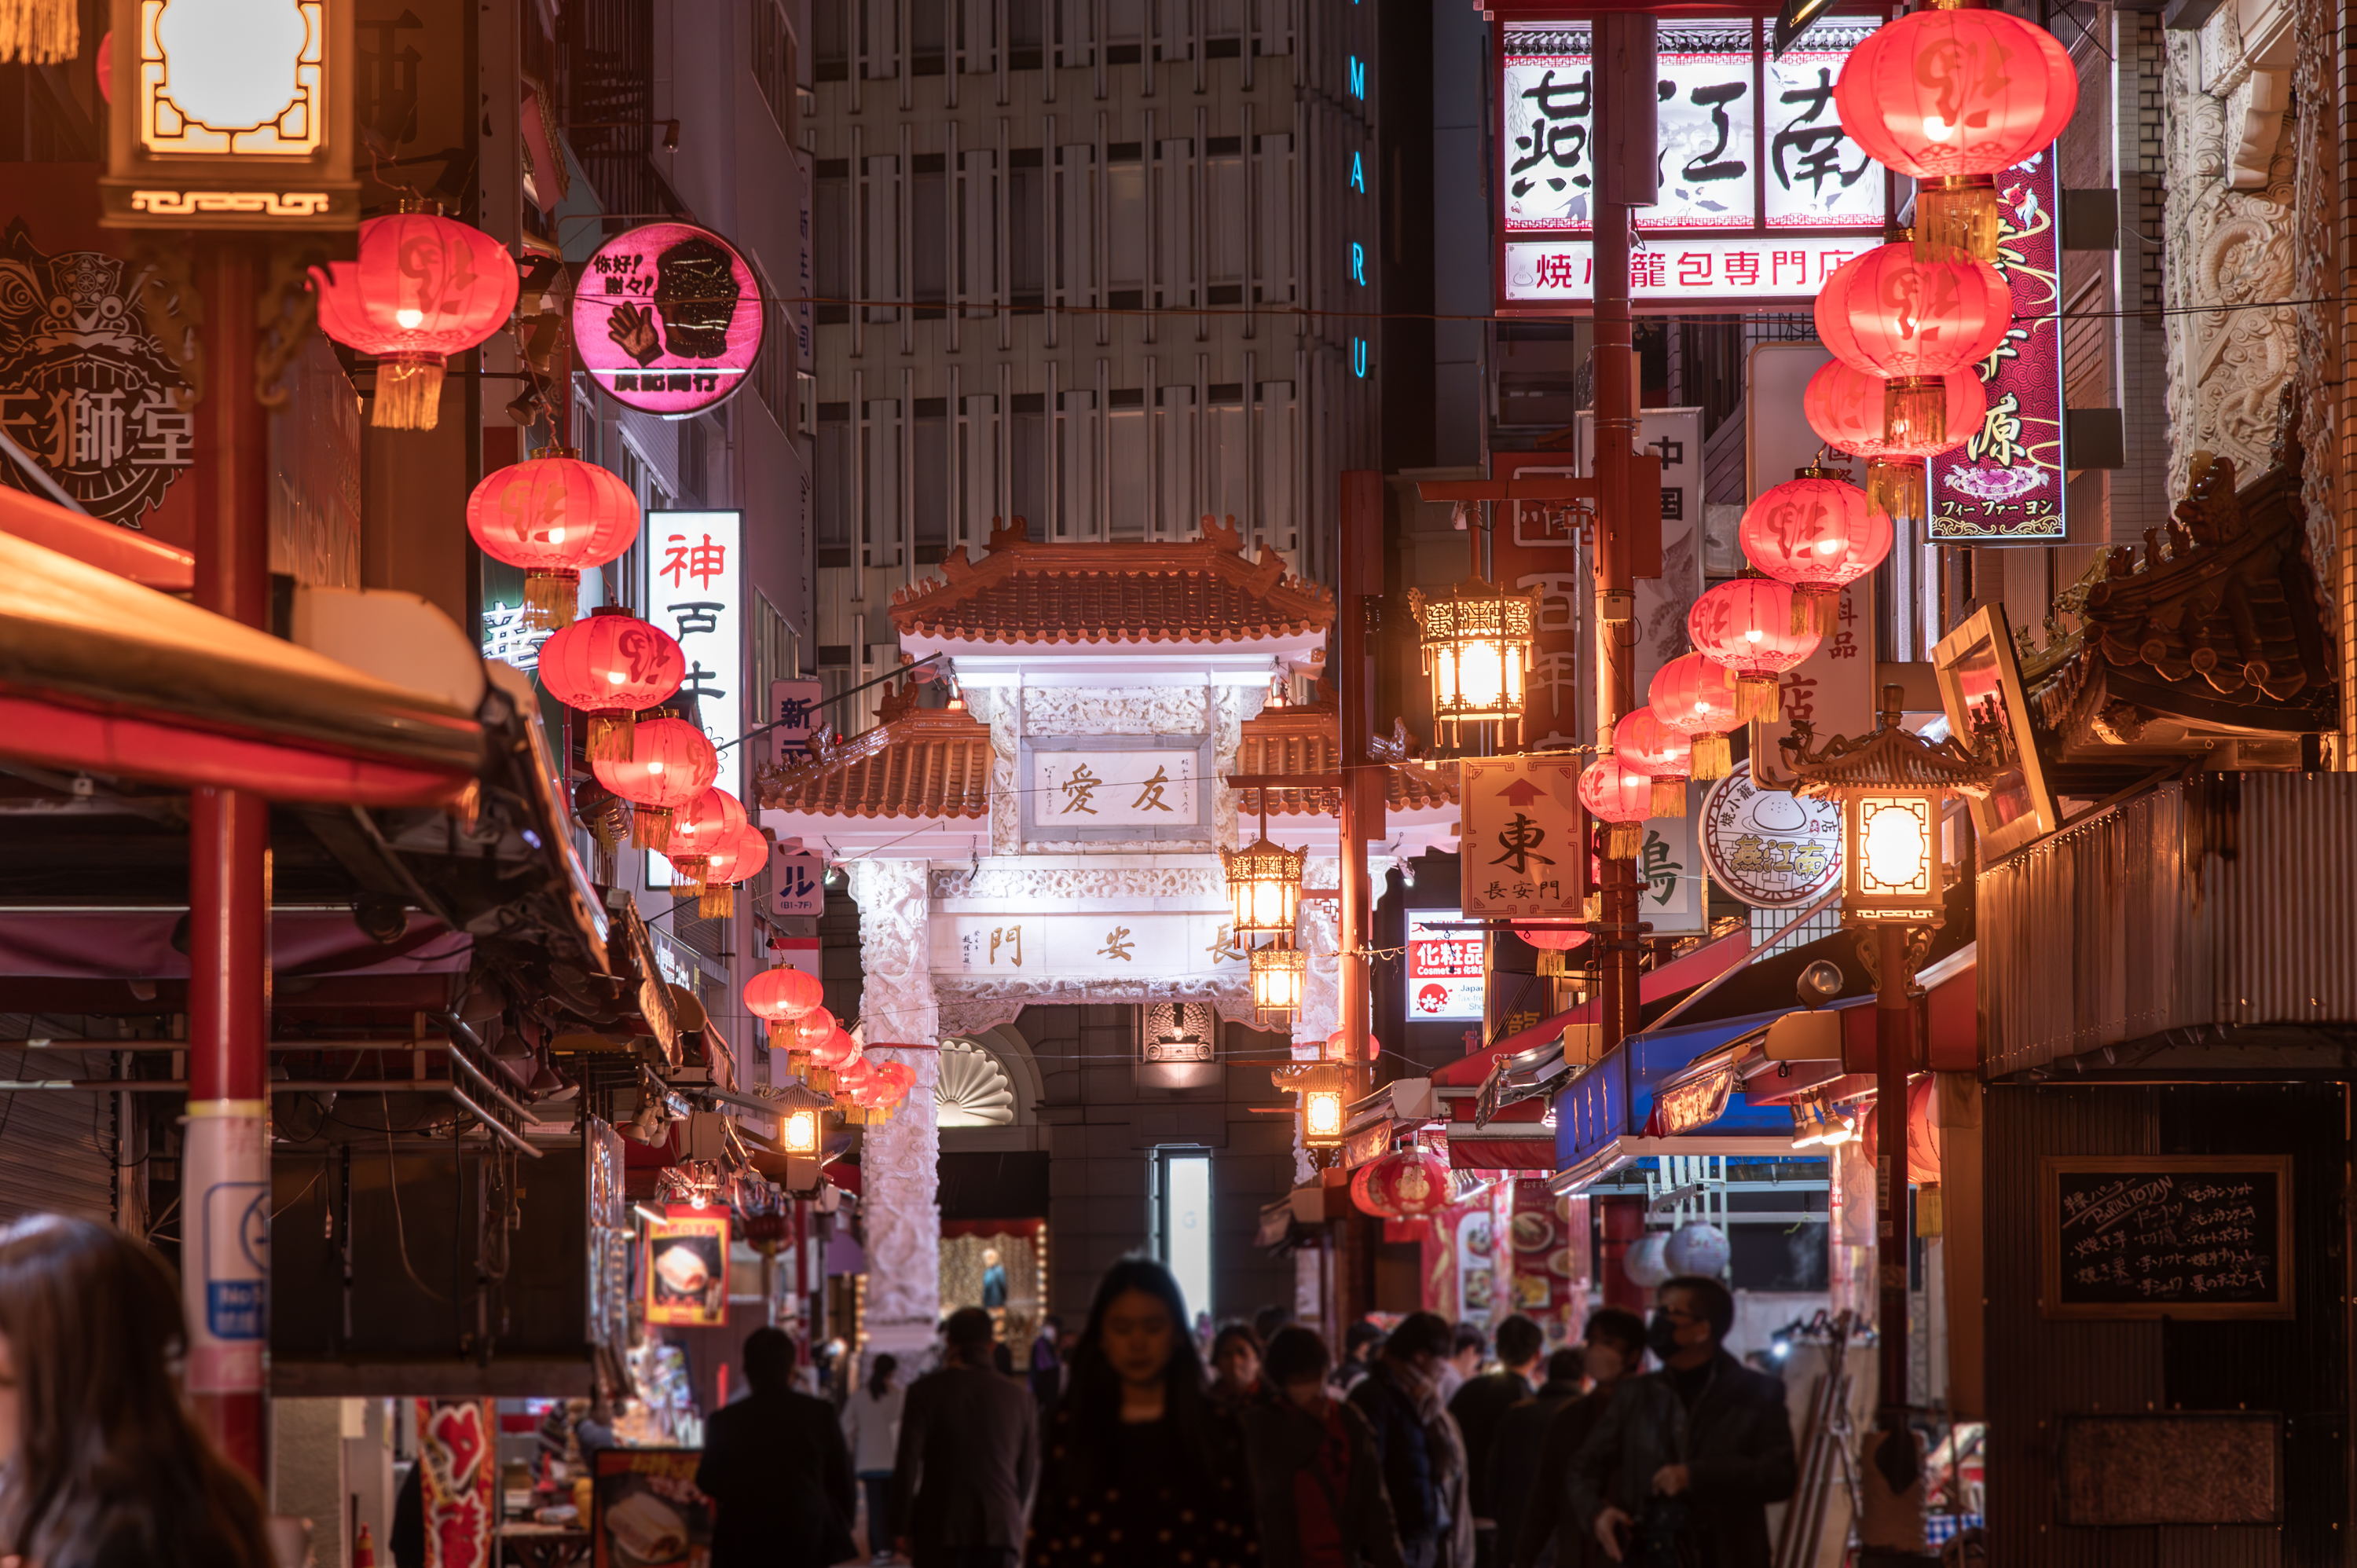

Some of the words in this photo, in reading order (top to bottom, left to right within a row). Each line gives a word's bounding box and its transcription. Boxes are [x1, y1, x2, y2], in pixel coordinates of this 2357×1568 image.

[1535, 249, 1854, 290] 焼籠包専門店
[1488, 812, 1556, 874] 東
[1731, 833, 1827, 879] 燕江南
[1483, 880, 1560, 900] 長安門
[1417, 943, 1483, 966] 化粧品
[1417, 965, 1462, 976] Cosmetcs
